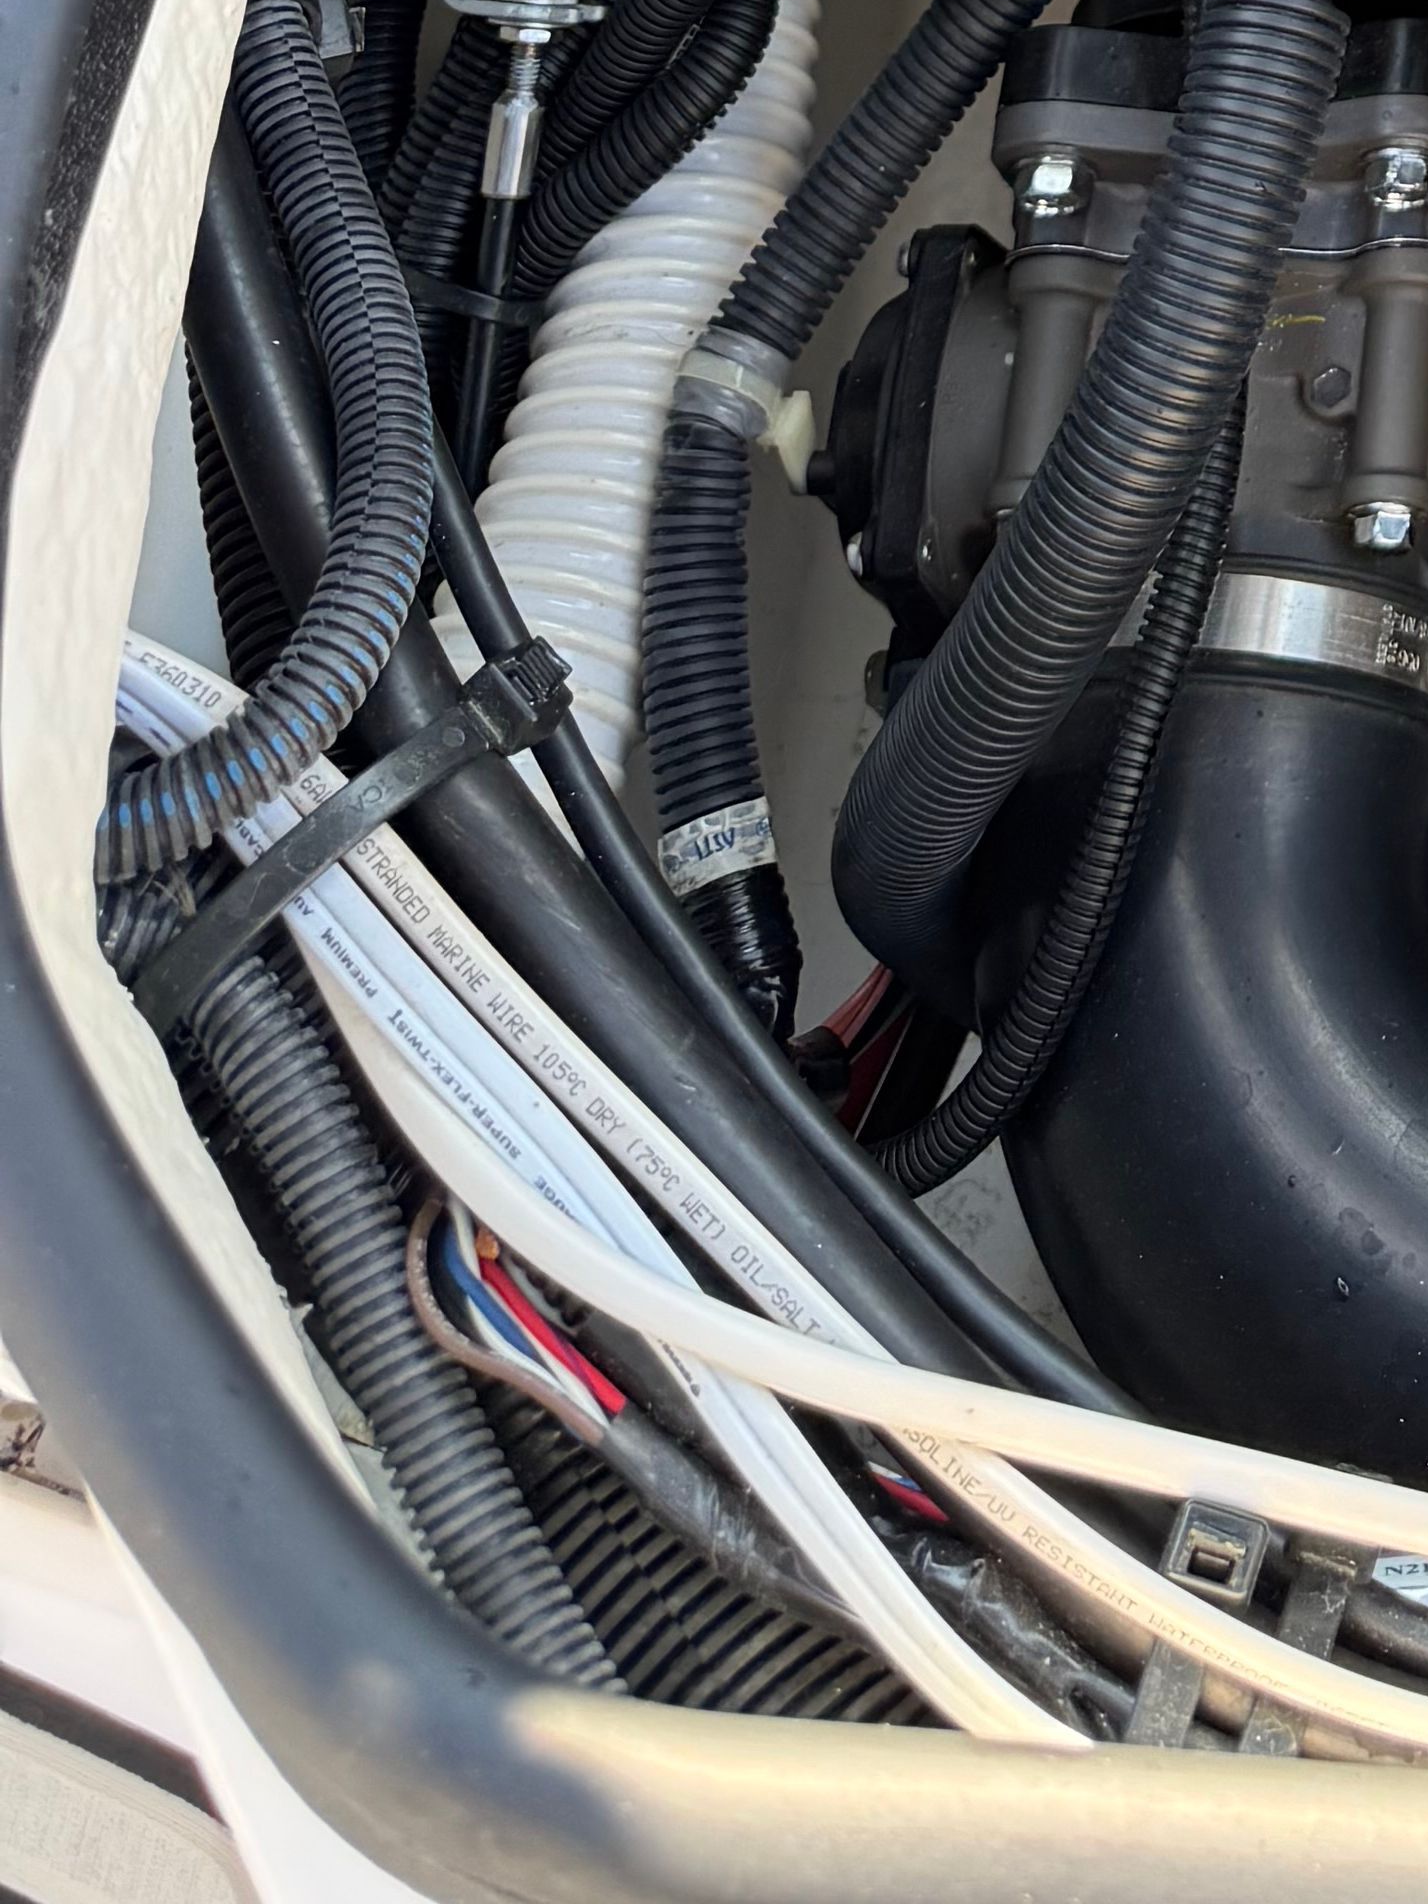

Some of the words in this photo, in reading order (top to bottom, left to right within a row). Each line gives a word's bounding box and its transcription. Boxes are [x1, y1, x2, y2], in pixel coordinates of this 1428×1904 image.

[318, 925, 381, 1001] PREMIUM
[354, 837, 432, 924] STRANDED
[426, 922, 492, 995] MARINE
[485, 991, 532, 1044] WIRE
[585, 1094, 629, 1140] DRY
[677, 1190, 731, 1243] WET)
[383, 1007, 521, 1161] SUPER-FLEX-TWIST
